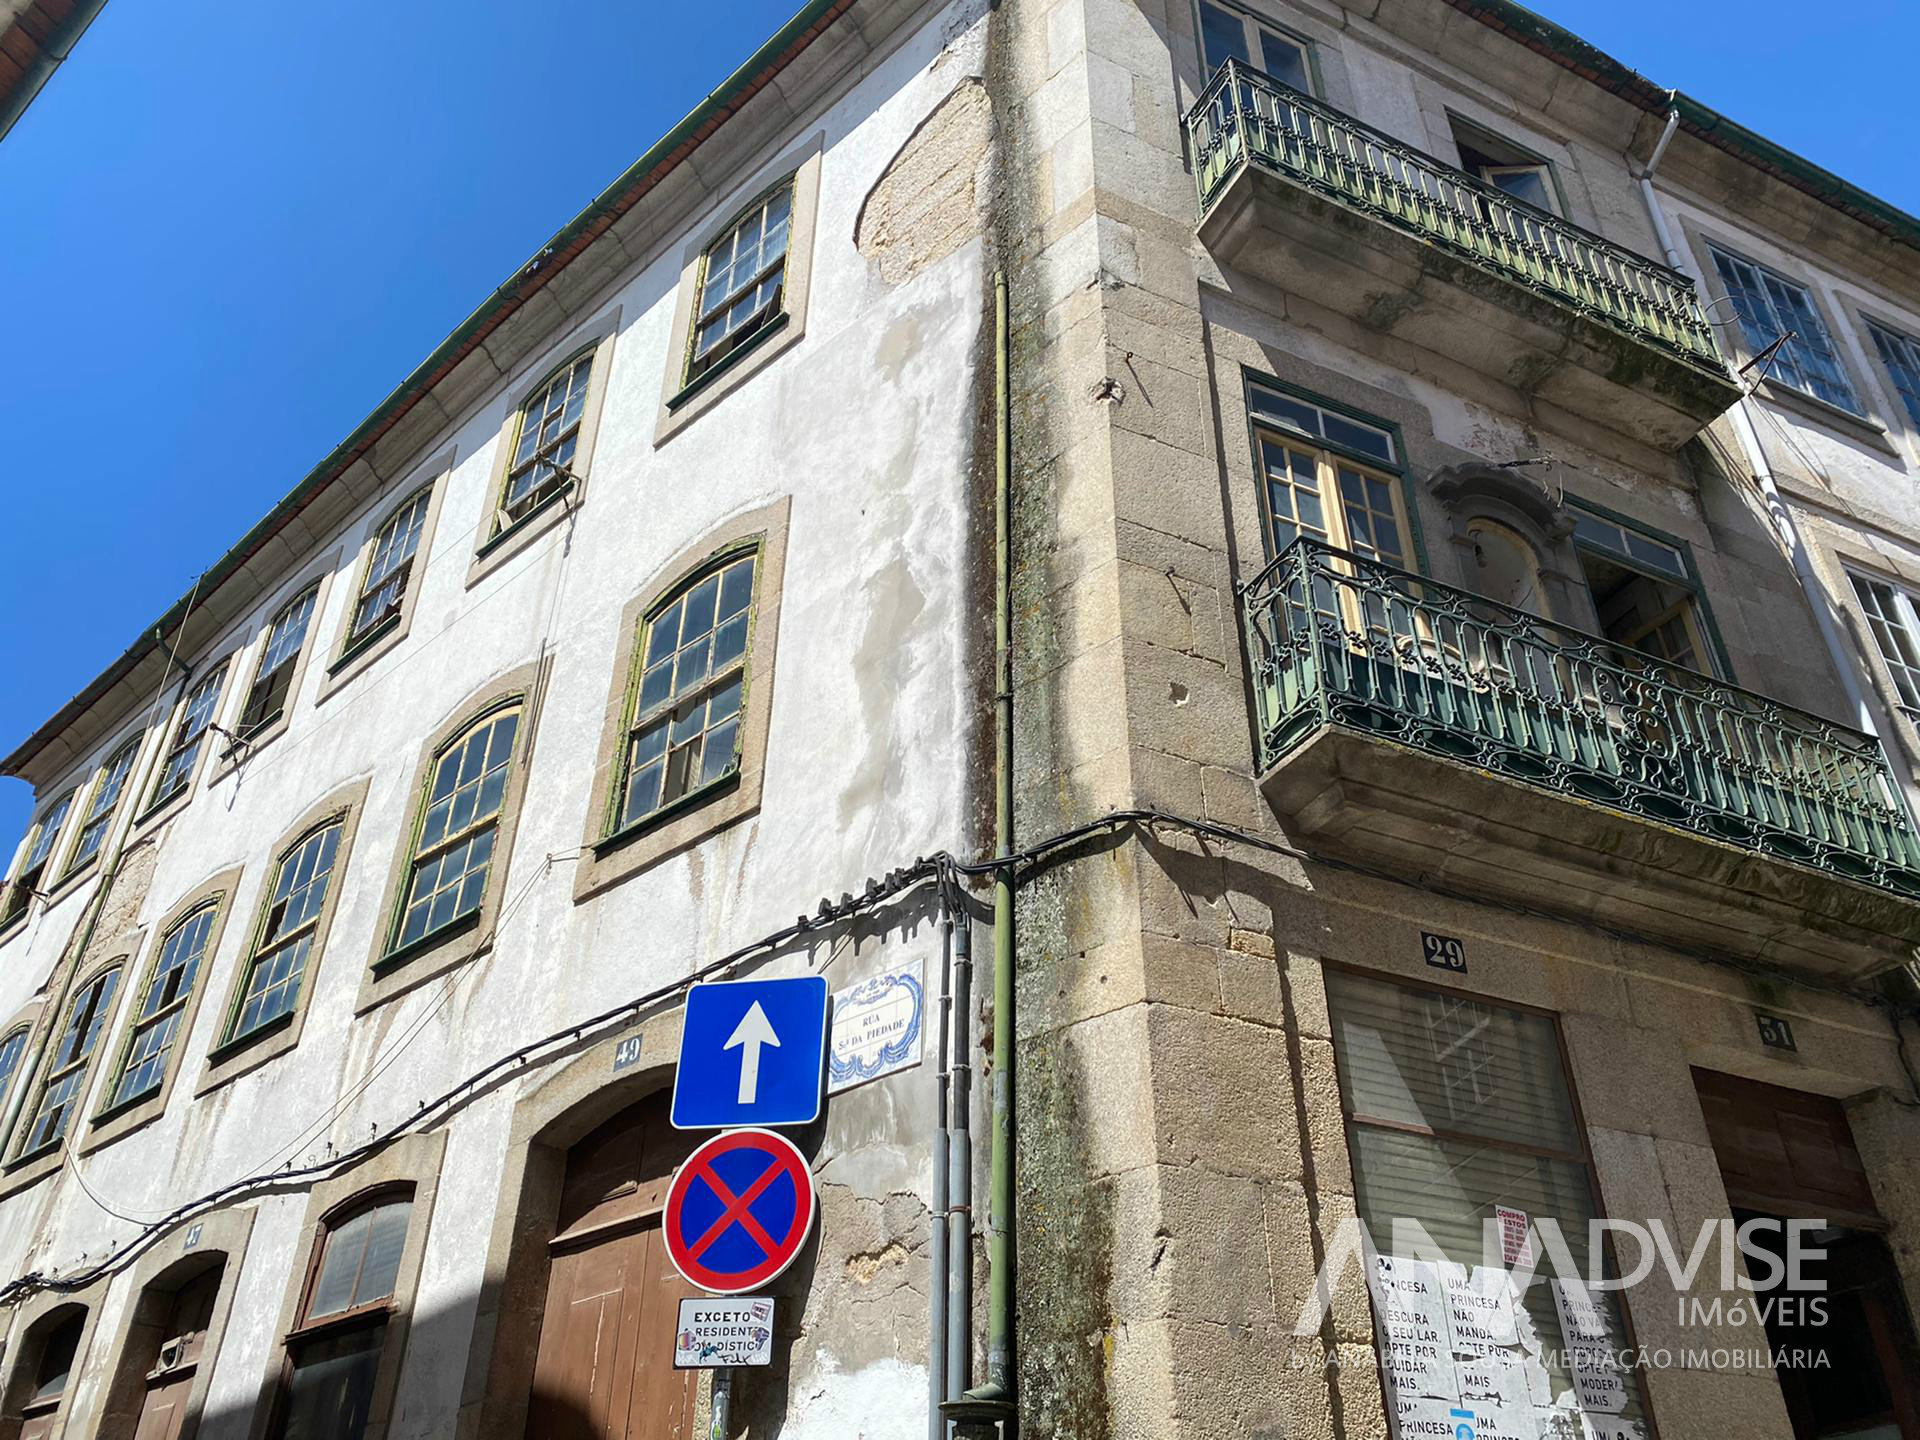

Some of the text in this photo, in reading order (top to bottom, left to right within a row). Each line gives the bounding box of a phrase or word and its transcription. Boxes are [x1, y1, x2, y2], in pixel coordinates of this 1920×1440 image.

[1425, 935, 1464, 968] 29
[862, 1013, 880, 1027] RUA
[851, 1035, 862, 1046] DA
[867, 1018, 905, 1040] PIEDADE
[1759, 1016, 1793, 1046] 31
[616, 1037, 640, 1063] 49
[186, 1224, 202, 1246] 47
[1451, 1293, 1501, 1310] PRINCESA
[694, 1311, 751, 1323] EXCETO
[1381, 1308, 1430, 1325] DESCURA
[1453, 1308, 1475, 1323] NÃO
[695, 1326, 758, 1337] RESIDENT
[1393, 1326, 1414, 1339] SEU
[1417, 1329, 1442, 1343] LAR.
[1456, 1325, 1497, 1341] MANDA.
[717, 1339, 758, 1351] DÍSTIC
[1384, 1341, 1437, 1359] OPTE POR
[1387, 1359, 1428, 1374] CUIDAR
[1389, 1375, 1420, 1390] MAIS.
[1464, 1374, 1490, 1388] MAIS
[1584, 1394, 1613, 1407] MAIS.
[1399, 1419, 1454, 1436] PRINCESA
